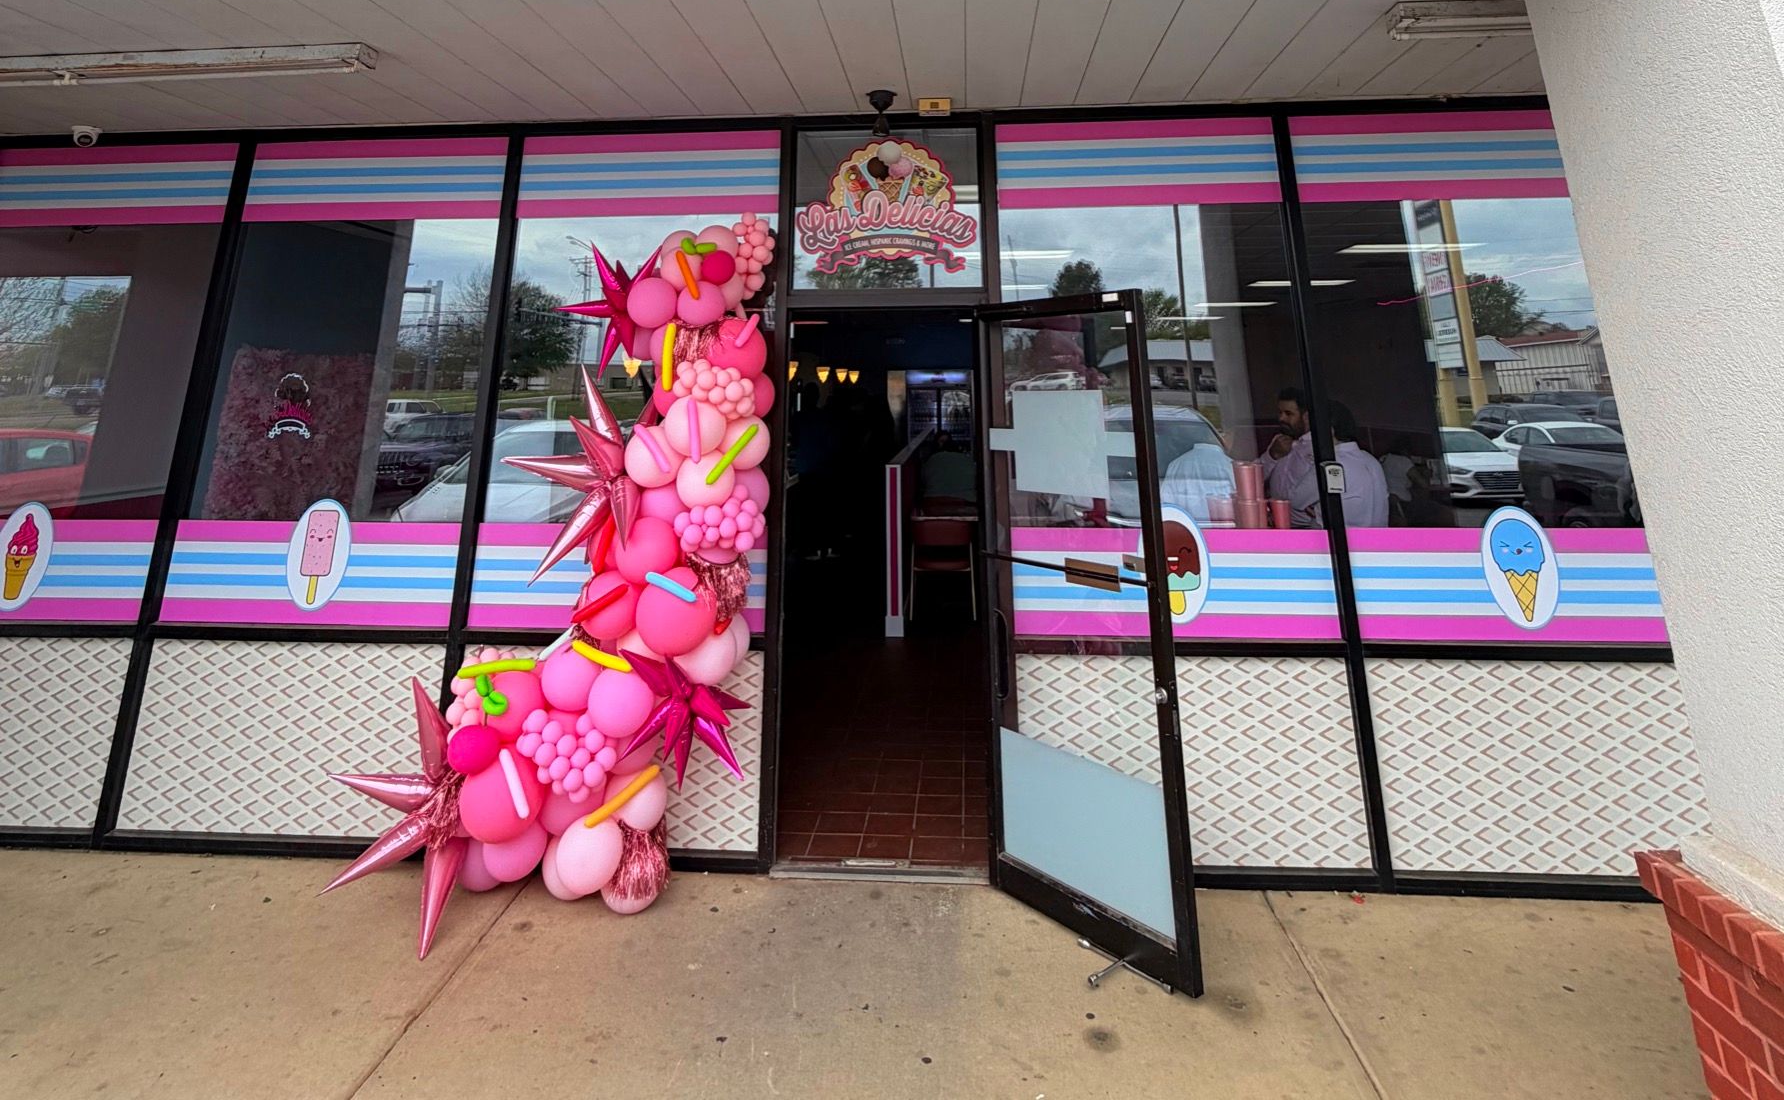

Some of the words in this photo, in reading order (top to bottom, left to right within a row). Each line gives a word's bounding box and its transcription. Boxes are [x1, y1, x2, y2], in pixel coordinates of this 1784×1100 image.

[800, 204, 856, 249] Las
[856, 190, 975, 240] Delicias
[844, 243, 852, 251] ICE
[870, 237, 892, 246] HISPANIC
[892, 237, 916, 246] CRAVINGS
[921, 240, 936, 250] MORE
